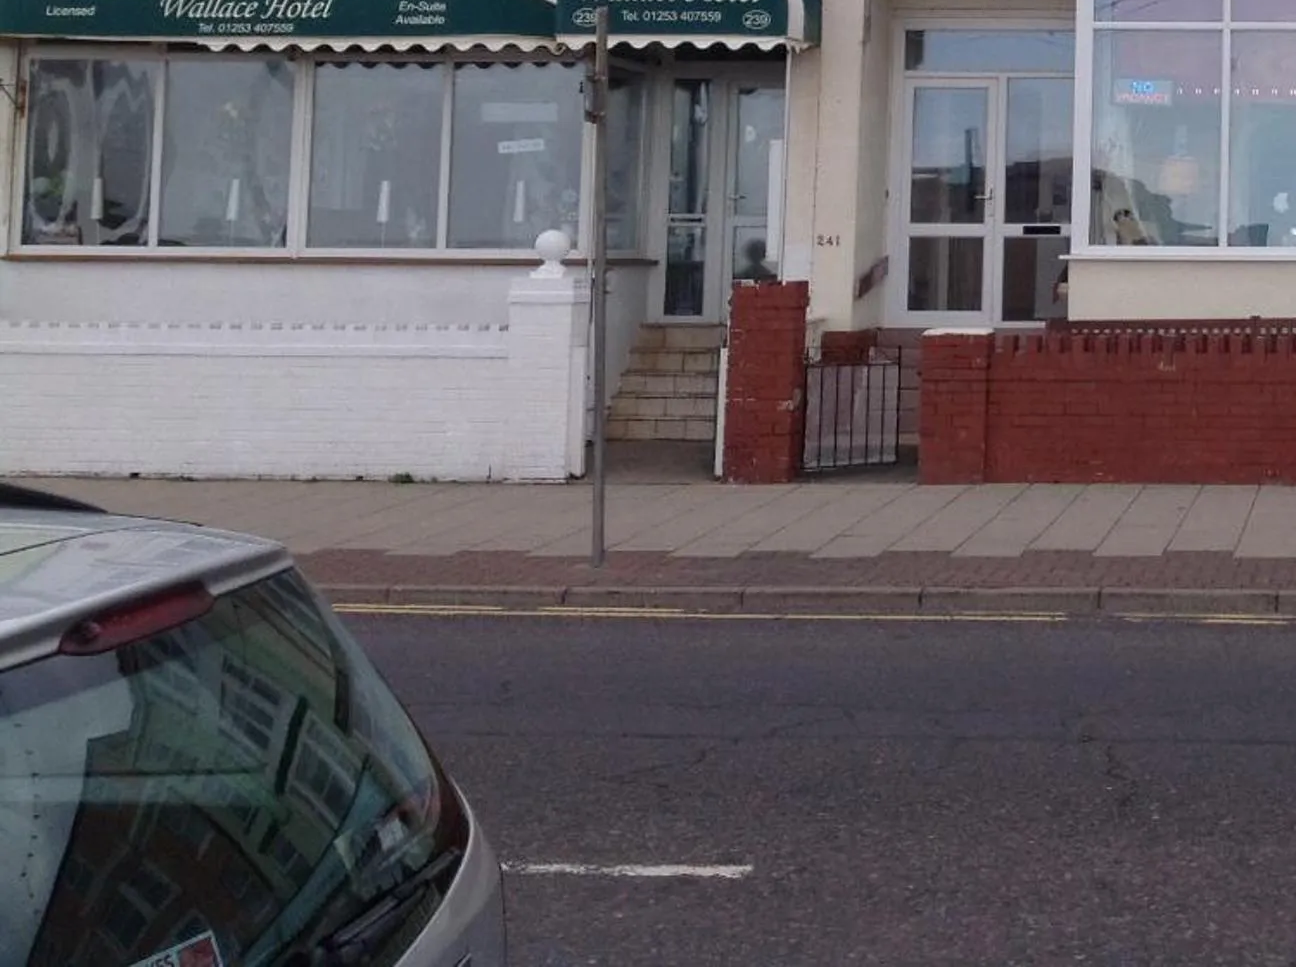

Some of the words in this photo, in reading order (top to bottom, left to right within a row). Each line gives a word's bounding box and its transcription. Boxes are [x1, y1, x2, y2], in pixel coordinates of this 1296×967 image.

[46, 5, 95, 17] Licensed
[399, 0, 447, 12] En-Suite
[395, 14, 446, 25] Available
[621, 10, 639, 21] Tel.
[642, 11, 678, 22] 01253
[679, 11, 722, 23] 407559
[218, 23, 251, 33] 01253
[816, 234, 840, 247] 241
